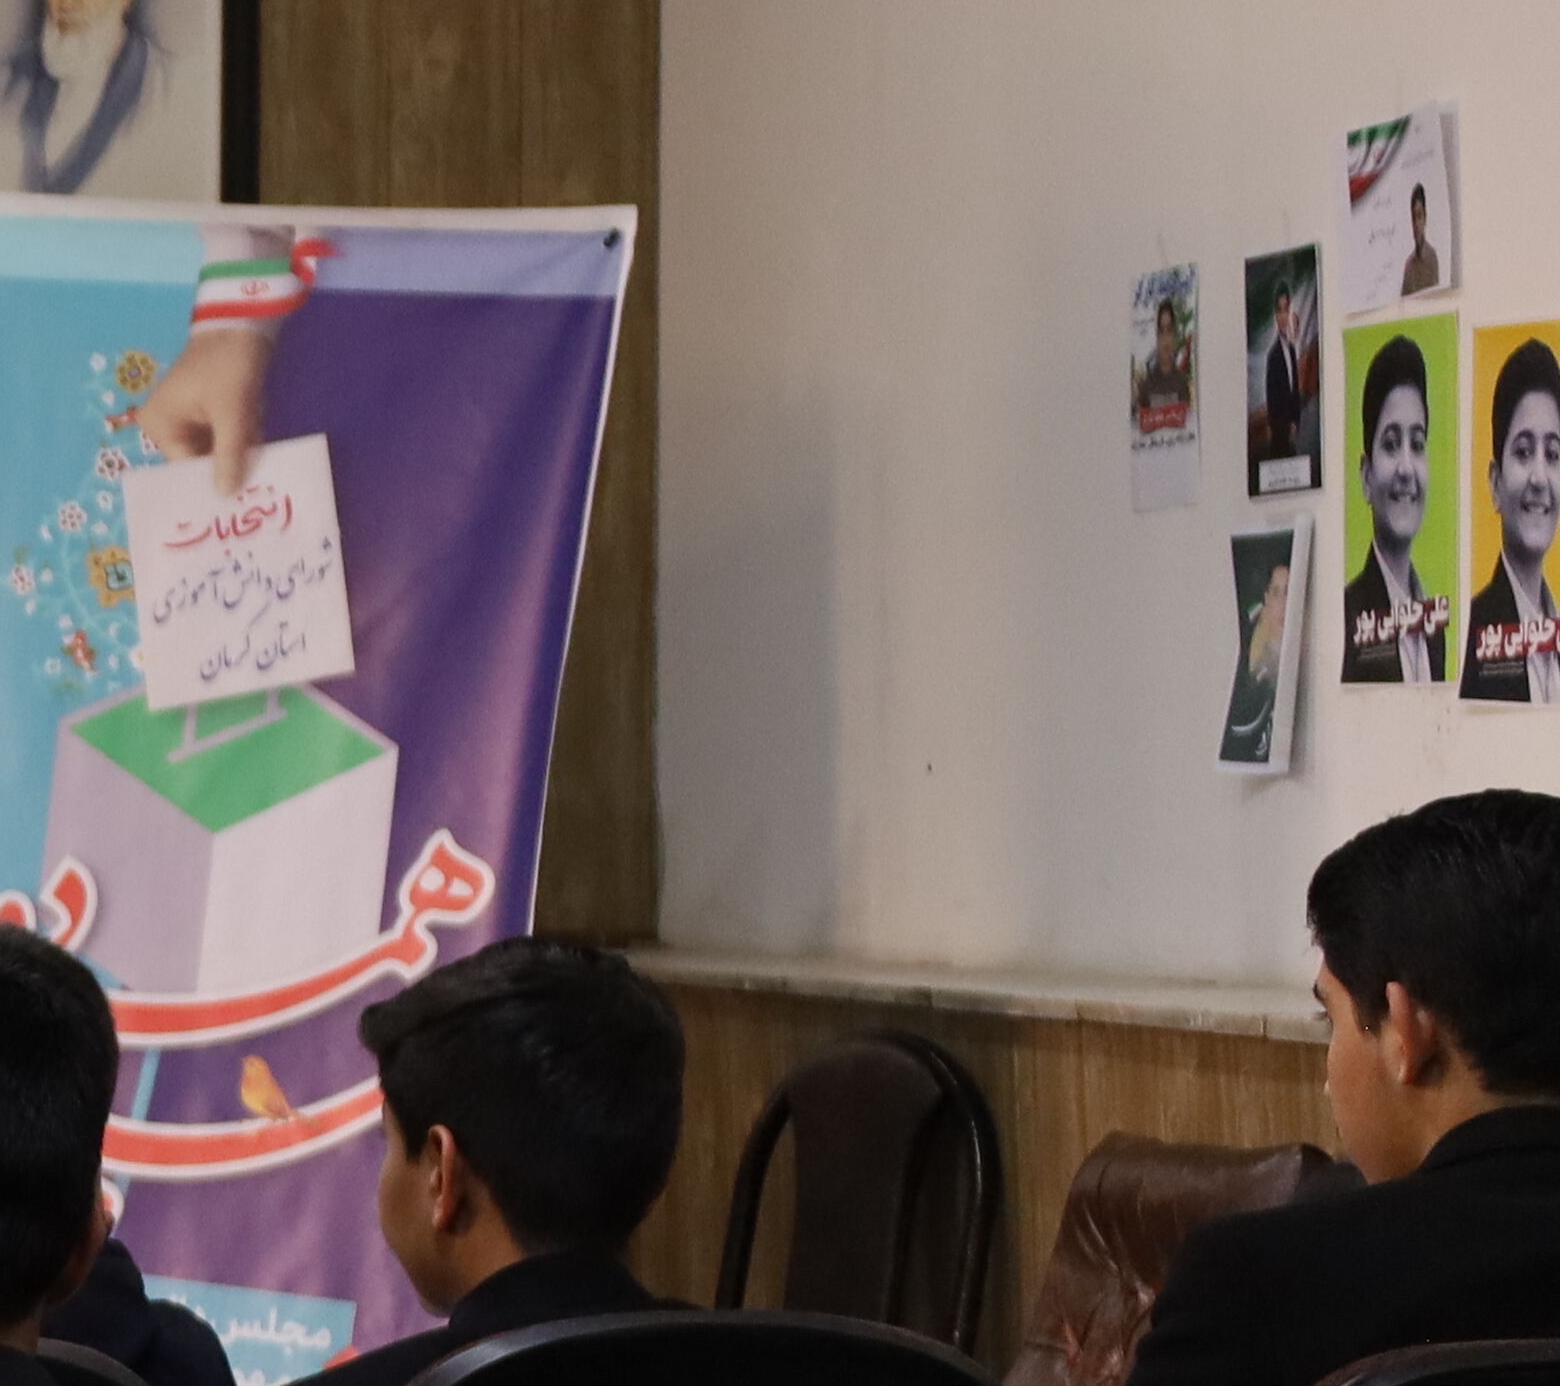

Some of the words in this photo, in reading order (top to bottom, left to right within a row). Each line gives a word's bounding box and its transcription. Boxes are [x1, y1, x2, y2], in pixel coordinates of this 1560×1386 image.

[163, 483, 294, 557] انتخابات
[222, 549, 274, 610] دانش
[275, 534, 337, 602] شورای
[1353, 609, 1376, 645] پور
[1376, 597, 1424, 642] حلوایی
[1424, 593, 1450, 637] علی
[1504, 613, 1557, 659] حلوایی
[255, 620, 306, 672] استان
[1475, 623, 1503, 660] پور
